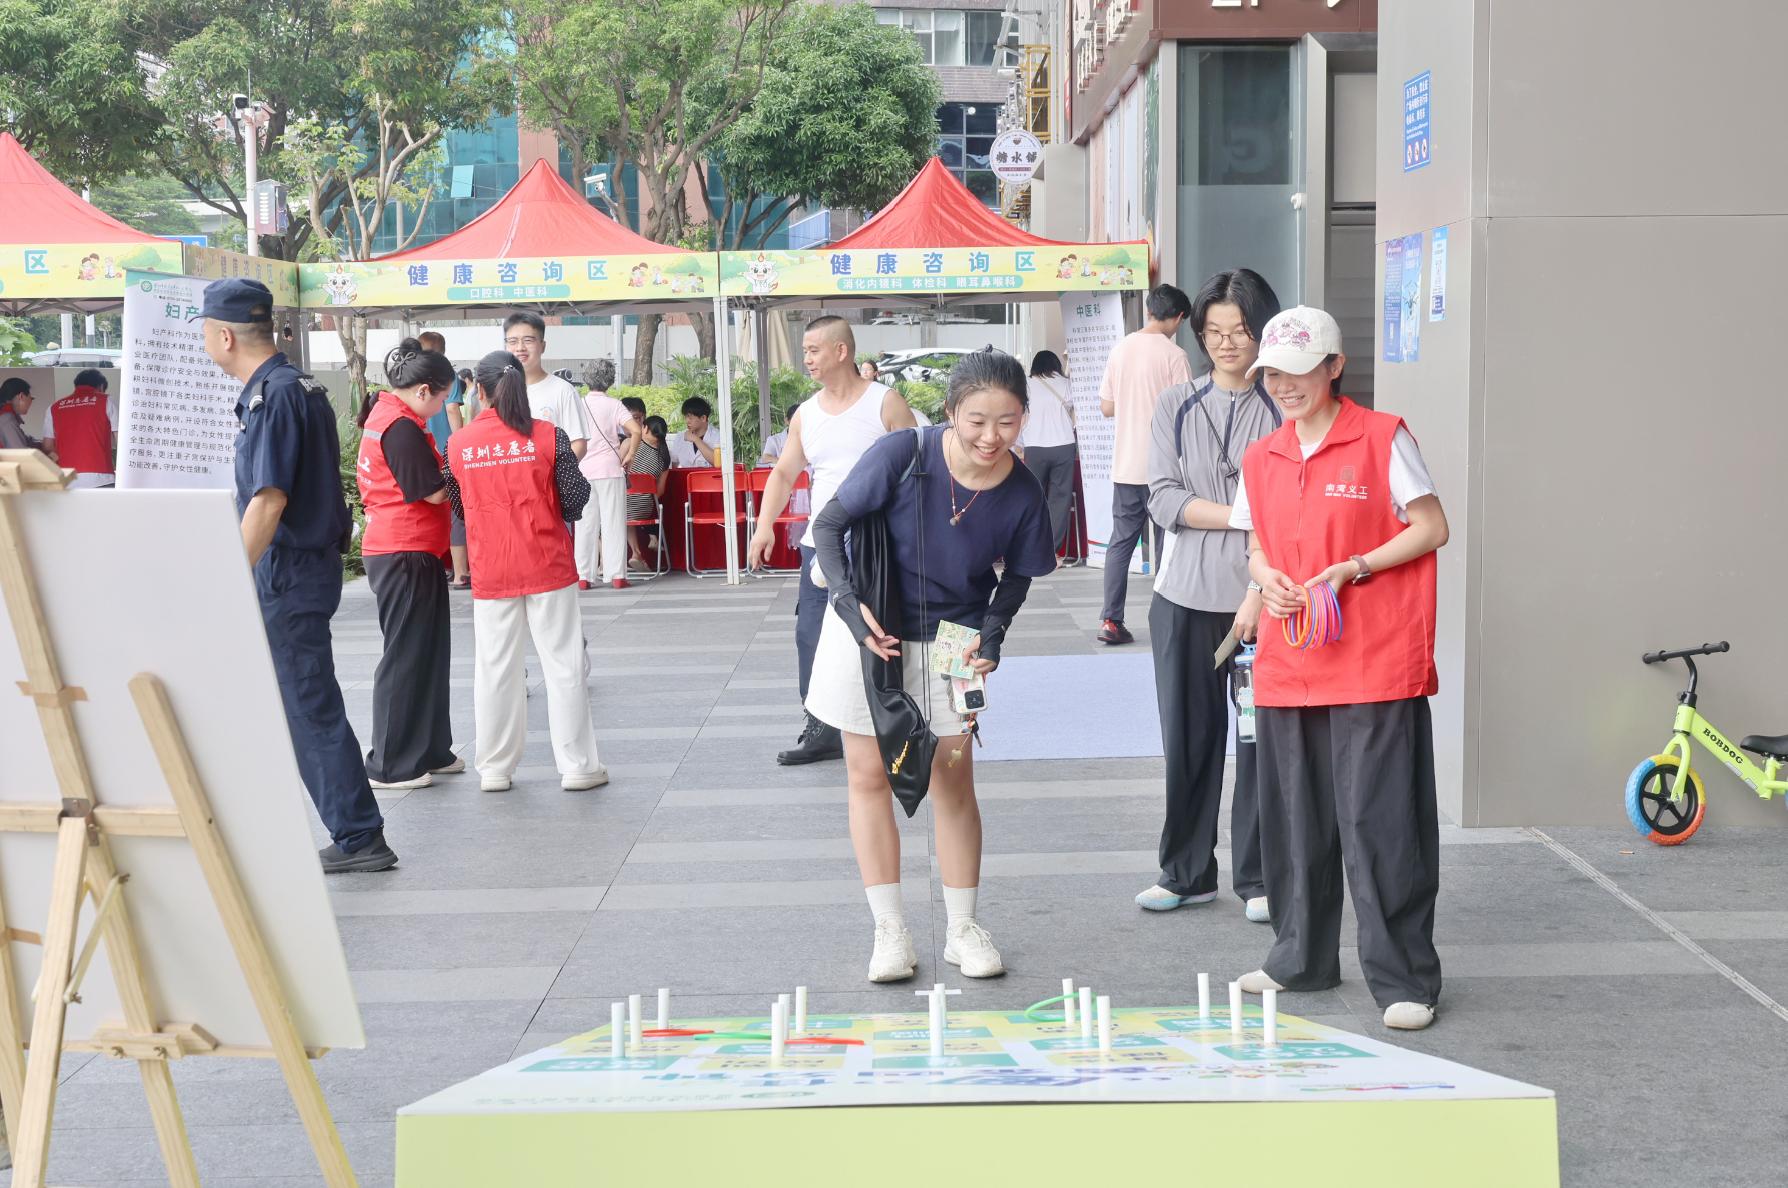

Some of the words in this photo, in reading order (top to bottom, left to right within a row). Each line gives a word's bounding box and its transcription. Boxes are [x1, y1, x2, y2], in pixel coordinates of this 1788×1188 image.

[996, 151, 1037, 164] 糖水铺
[24, 249, 50, 275] 区
[830, 251, 1036, 275] 健康咨询区
[407, 260, 609, 286] 健康咨询区
[842, 277, 903, 290] 消化内镜科
[912, 277, 947, 288] 体检科
[956, 276, 1016, 288] 眼耳鼻喉科
[470, 287, 504, 298] 口腔科
[513, 286, 548, 298] 中医科
[165, 302, 200, 320] 妇产
[1076, 303, 1101, 318] 中医科
[132, 399, 236, 416] 诊治妇科常见病、多发病、急危
[461, 439, 535, 462] 深圳志愿者
[464, 460, 497, 470] SHENZHEN
[499, 455, 536, 465] VOLUNTEER
[1325, 483, 1368, 495] 南湾义工
[1702, 727, 1744, 765] BOBDOG
